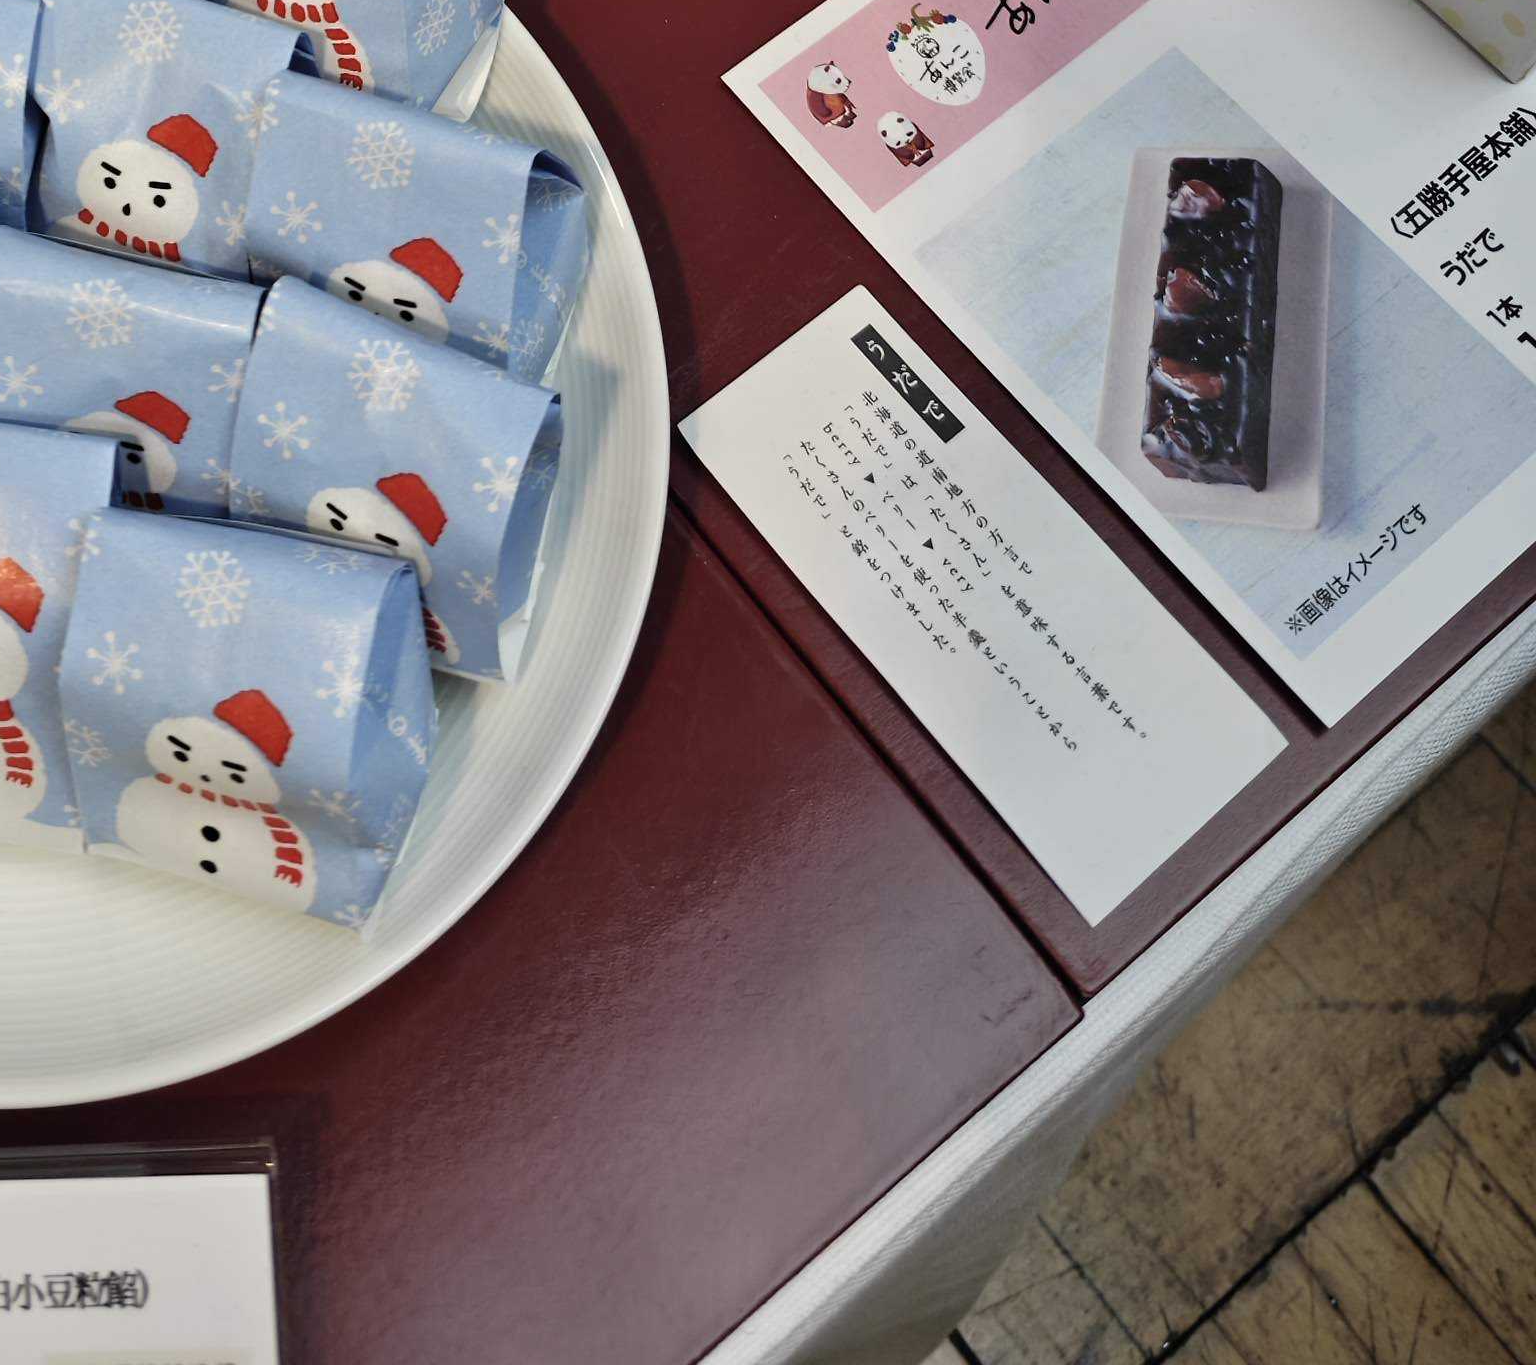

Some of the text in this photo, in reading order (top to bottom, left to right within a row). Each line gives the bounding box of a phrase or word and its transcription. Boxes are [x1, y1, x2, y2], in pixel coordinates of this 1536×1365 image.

[1439, 227, 1505, 286] うだで
[1485, 295, 1524, 328] 1本
[865, 340, 945, 423] うだで
